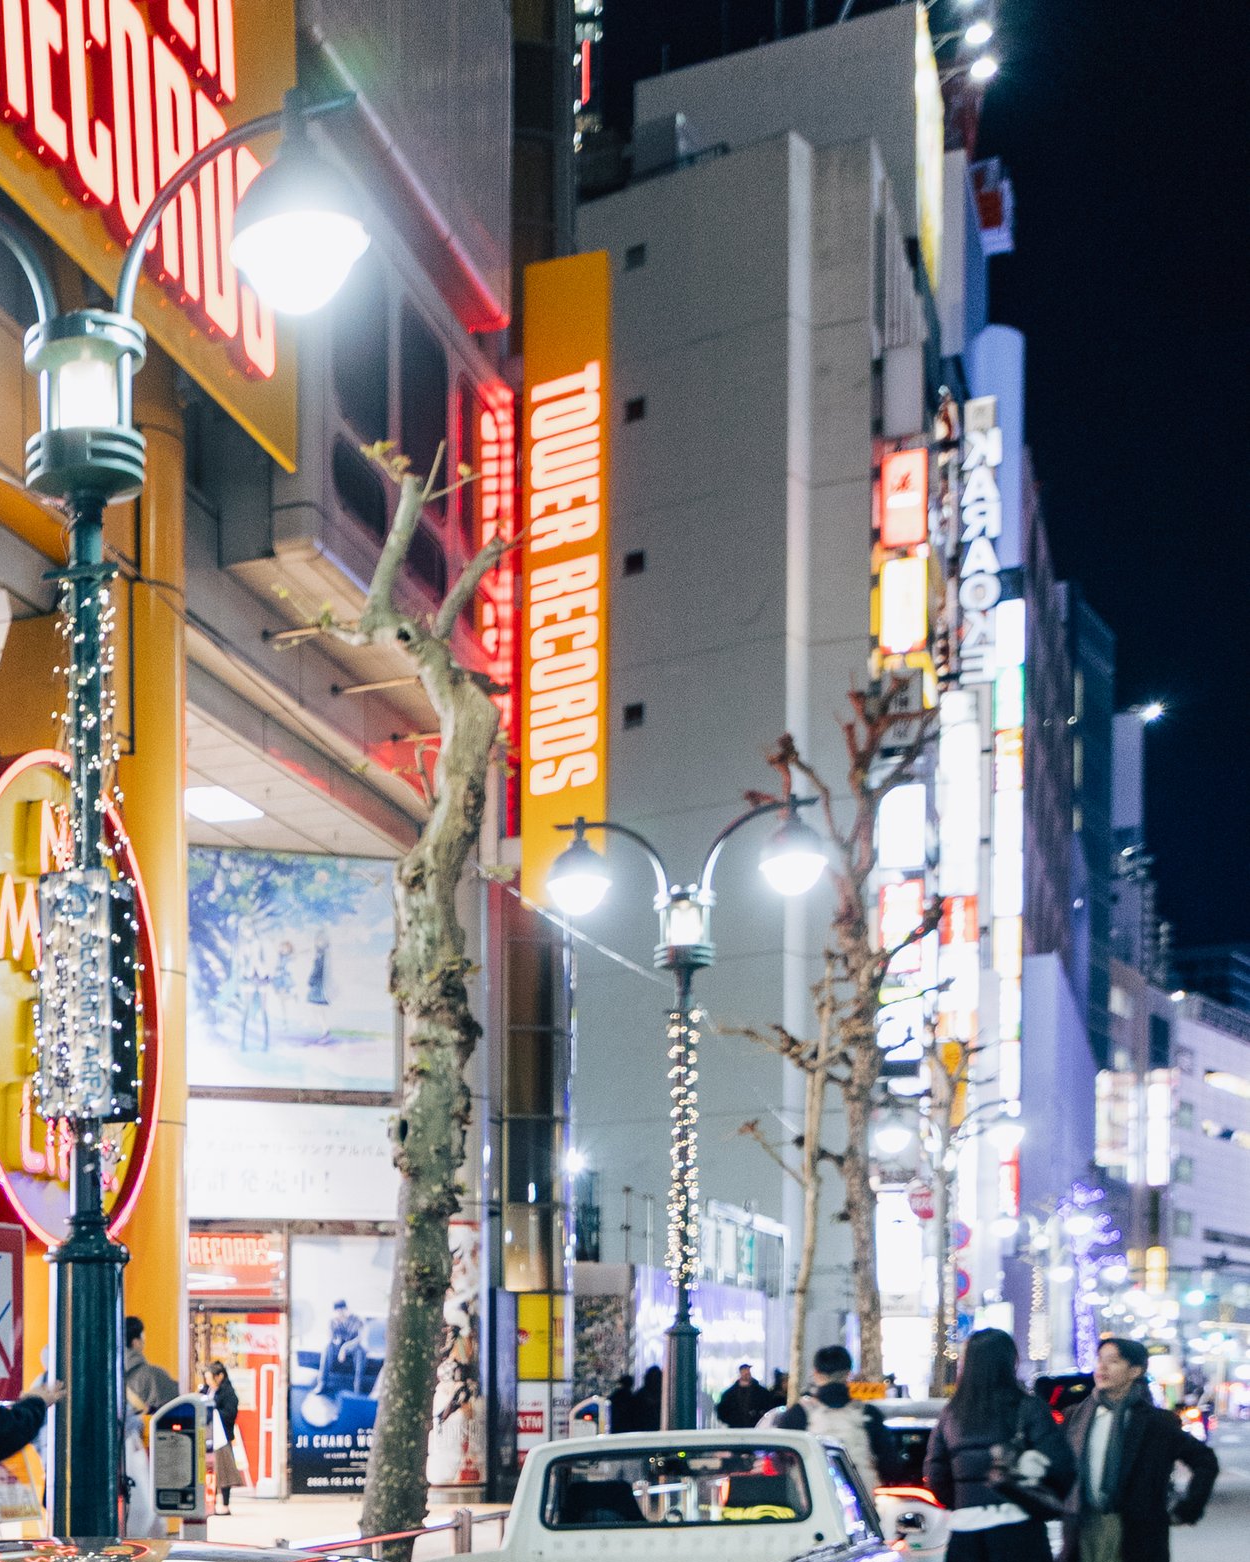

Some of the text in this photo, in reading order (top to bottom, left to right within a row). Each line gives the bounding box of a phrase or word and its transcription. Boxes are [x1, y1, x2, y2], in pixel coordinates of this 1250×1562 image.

[530, 360, 601, 796] TOWER RECORDS
[189, 1237, 270, 1265] RECORDS
[517, 1415, 543, 1430] ATM
[296, 1434, 375, 1448] JI CHANG WO
